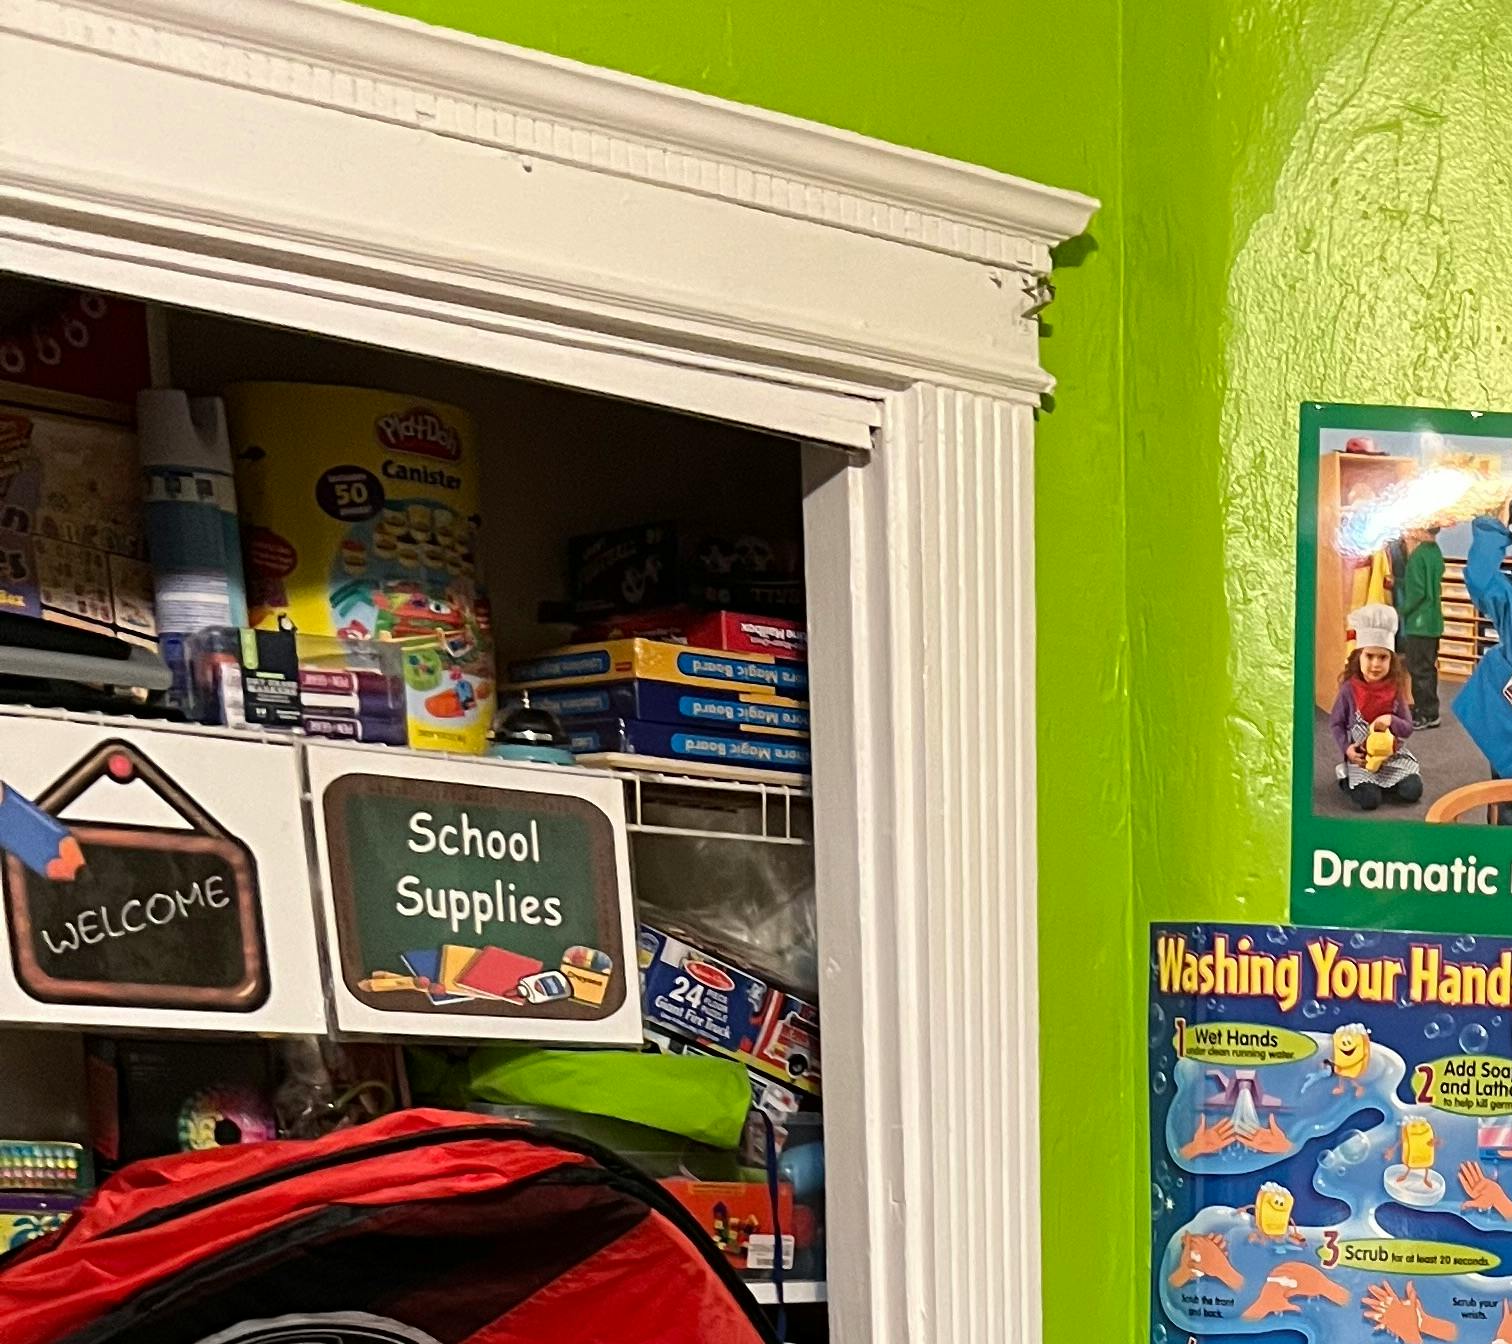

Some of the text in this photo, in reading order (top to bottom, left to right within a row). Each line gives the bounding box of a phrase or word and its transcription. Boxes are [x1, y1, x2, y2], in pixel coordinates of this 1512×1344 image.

[381, 459, 463, 490] Canister
[334, 482, 369, 505] 50
[692, 659, 734, 678] Board
[736, 662, 778, 684] Magic
[692, 702, 734, 719] Board
[736, 705, 779, 725] Magic
[684, 739, 727, 756] Board
[728, 741, 772, 760] Magic
[407, 811, 541, 863] School
[1312, 848, 1499, 896] Dramatic
[41, 875, 231, 954] WELCOME
[395, 874, 563, 936] Supplies
[1156, 933, 1302, 1013] Washing
[1306, 936, 1404, 1001] Your
[668, 975, 705, 1009] 24
[1175, 1018, 1279, 1058] 1 Wet Hands
[1185, 1046, 1207, 1056] under
[1207, 1047, 1232, 1058] clean
[1231, 1049, 1267, 1061] running
[1416, 1063, 1435, 1104] 2
[1443, 1060, 1477, 1078] Add
[1439, 1079, 1471, 1096] and
[1442, 1097, 1453, 1107] to
[1454, 1097, 1474, 1110] help
[1475, 1099, 1489, 1108] kill
[1322, 1230, 1490, 1267] 3 Scrub for at least 20 seconds.
[1451, 1297, 1499, 1311] Scrub your
